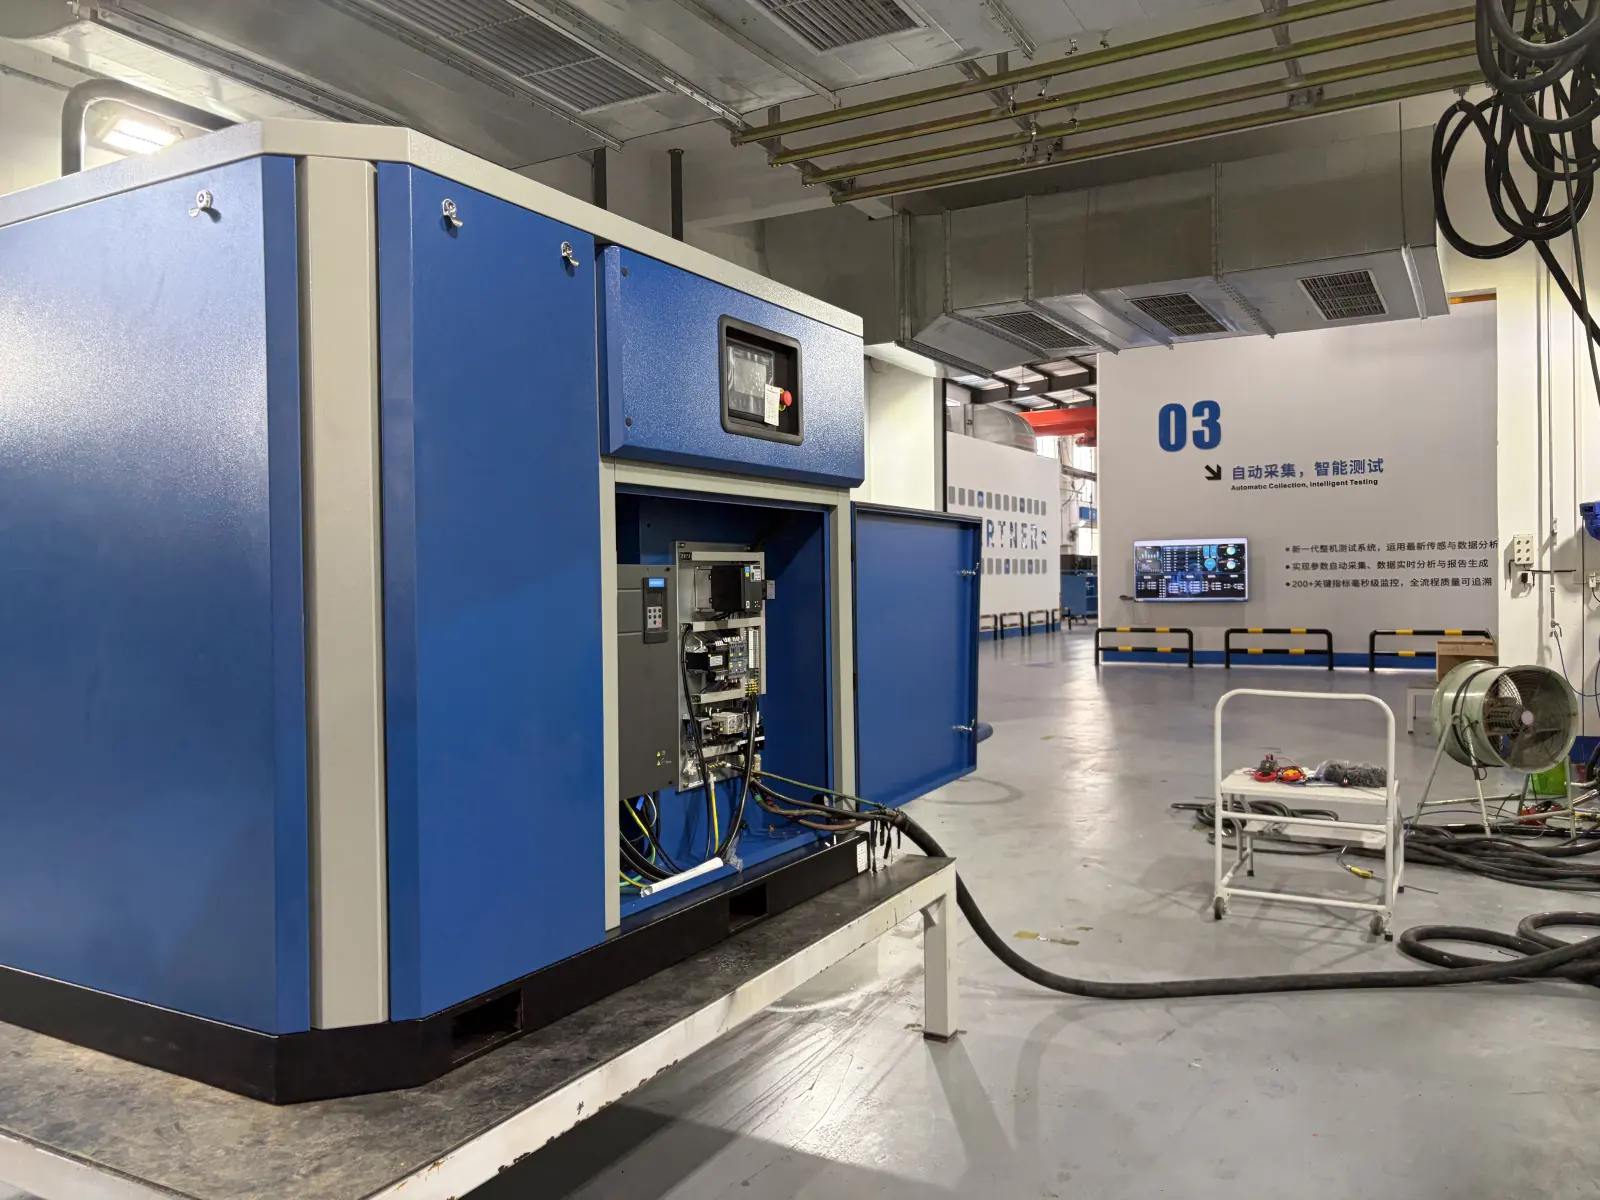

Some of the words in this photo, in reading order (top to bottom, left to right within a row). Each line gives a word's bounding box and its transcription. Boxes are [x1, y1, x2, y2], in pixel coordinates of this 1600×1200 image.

[1158, 400, 1222, 453] 03
[1232, 458, 1384, 480] 自动采集，智能测试
[1269, 482, 1308, 490] Collection,
[1310, 480, 1348, 488] Intelligent
[1350, 478, 1378, 486] Testing
[1292, 540, 1498, 553] 新一代整机测试系统，运用最新传感与数据分析
[1292, 559, 1489, 570] 实现参数自动采集、数据实时分析与报告生成
[1292, 577, 1492, 588] 200+关键指标毫秒级监控，全流程质量可追溯
